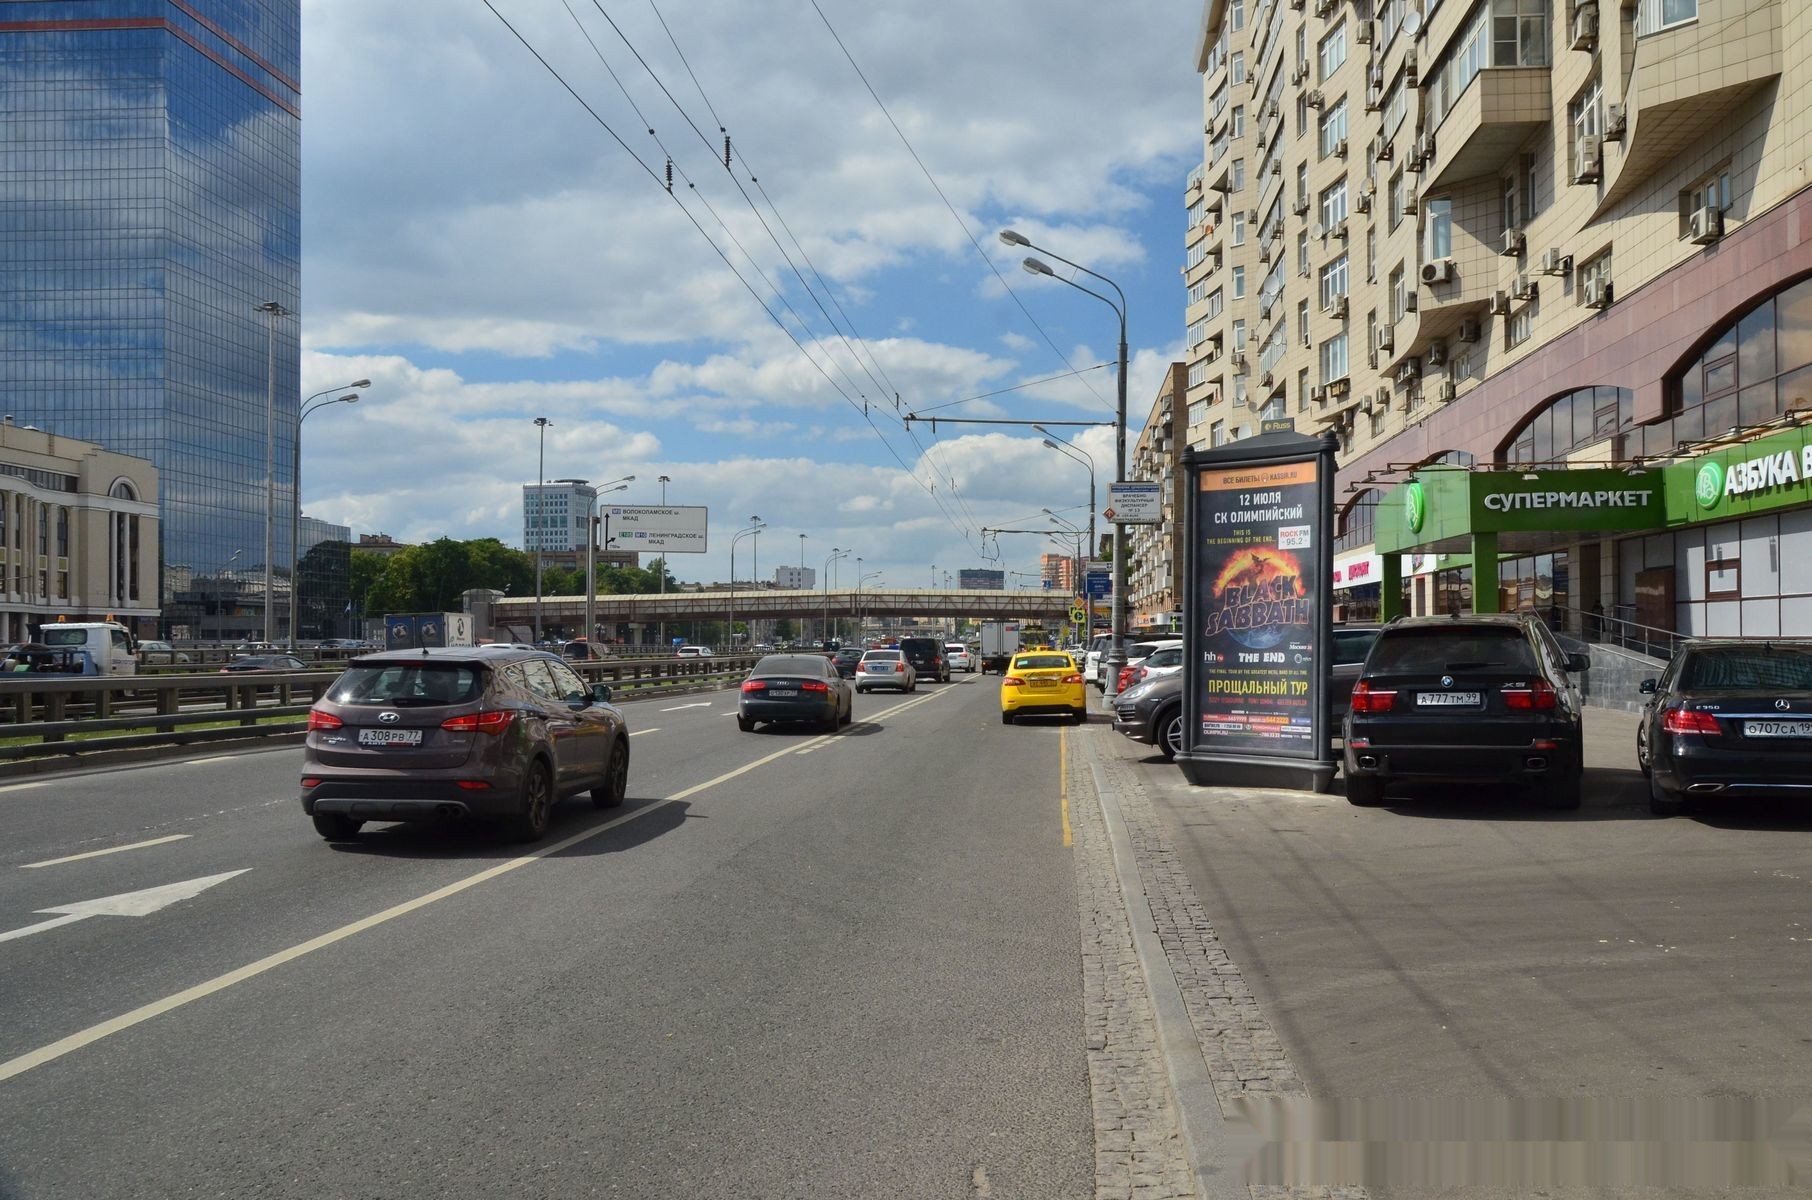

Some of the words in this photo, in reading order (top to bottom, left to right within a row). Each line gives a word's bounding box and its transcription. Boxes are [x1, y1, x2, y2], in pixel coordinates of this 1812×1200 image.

[1223, 476, 1234, 484] ВСЕ
[1235, 474, 1260, 484] БИЛЕТЫ
[1724, 450, 1798, 496] АЗБУКА
[1240, 494, 1250, 506] 12
[1253, 491, 1281, 506] ИЮЛЯ
[1485, 489, 1653, 513] СУПЕРМАРКЕТ
[1215, 512, 1228, 524] СК
[1231, 504, 1303, 524] ОЛИМПИЙСКИЙ
[1207, 537, 1216, 545] THE
[1280, 530, 1298, 539] ROCK
[1299, 528, 1310, 537] FM
[1224, 575, 1298, 610] BLACK
[1205, 599, 1310, 636] SABBATH
[1204, 651, 1216, 661] hh
[1239, 653, 1259, 663] THE
[1263, 653, 1285, 663] END
[1208, 679, 1287, 695] ПРОЩАЛЬНЫЙ
[1290, 681, 1308, 695] ТУР
[1799, 722, 1812, 732] 19
